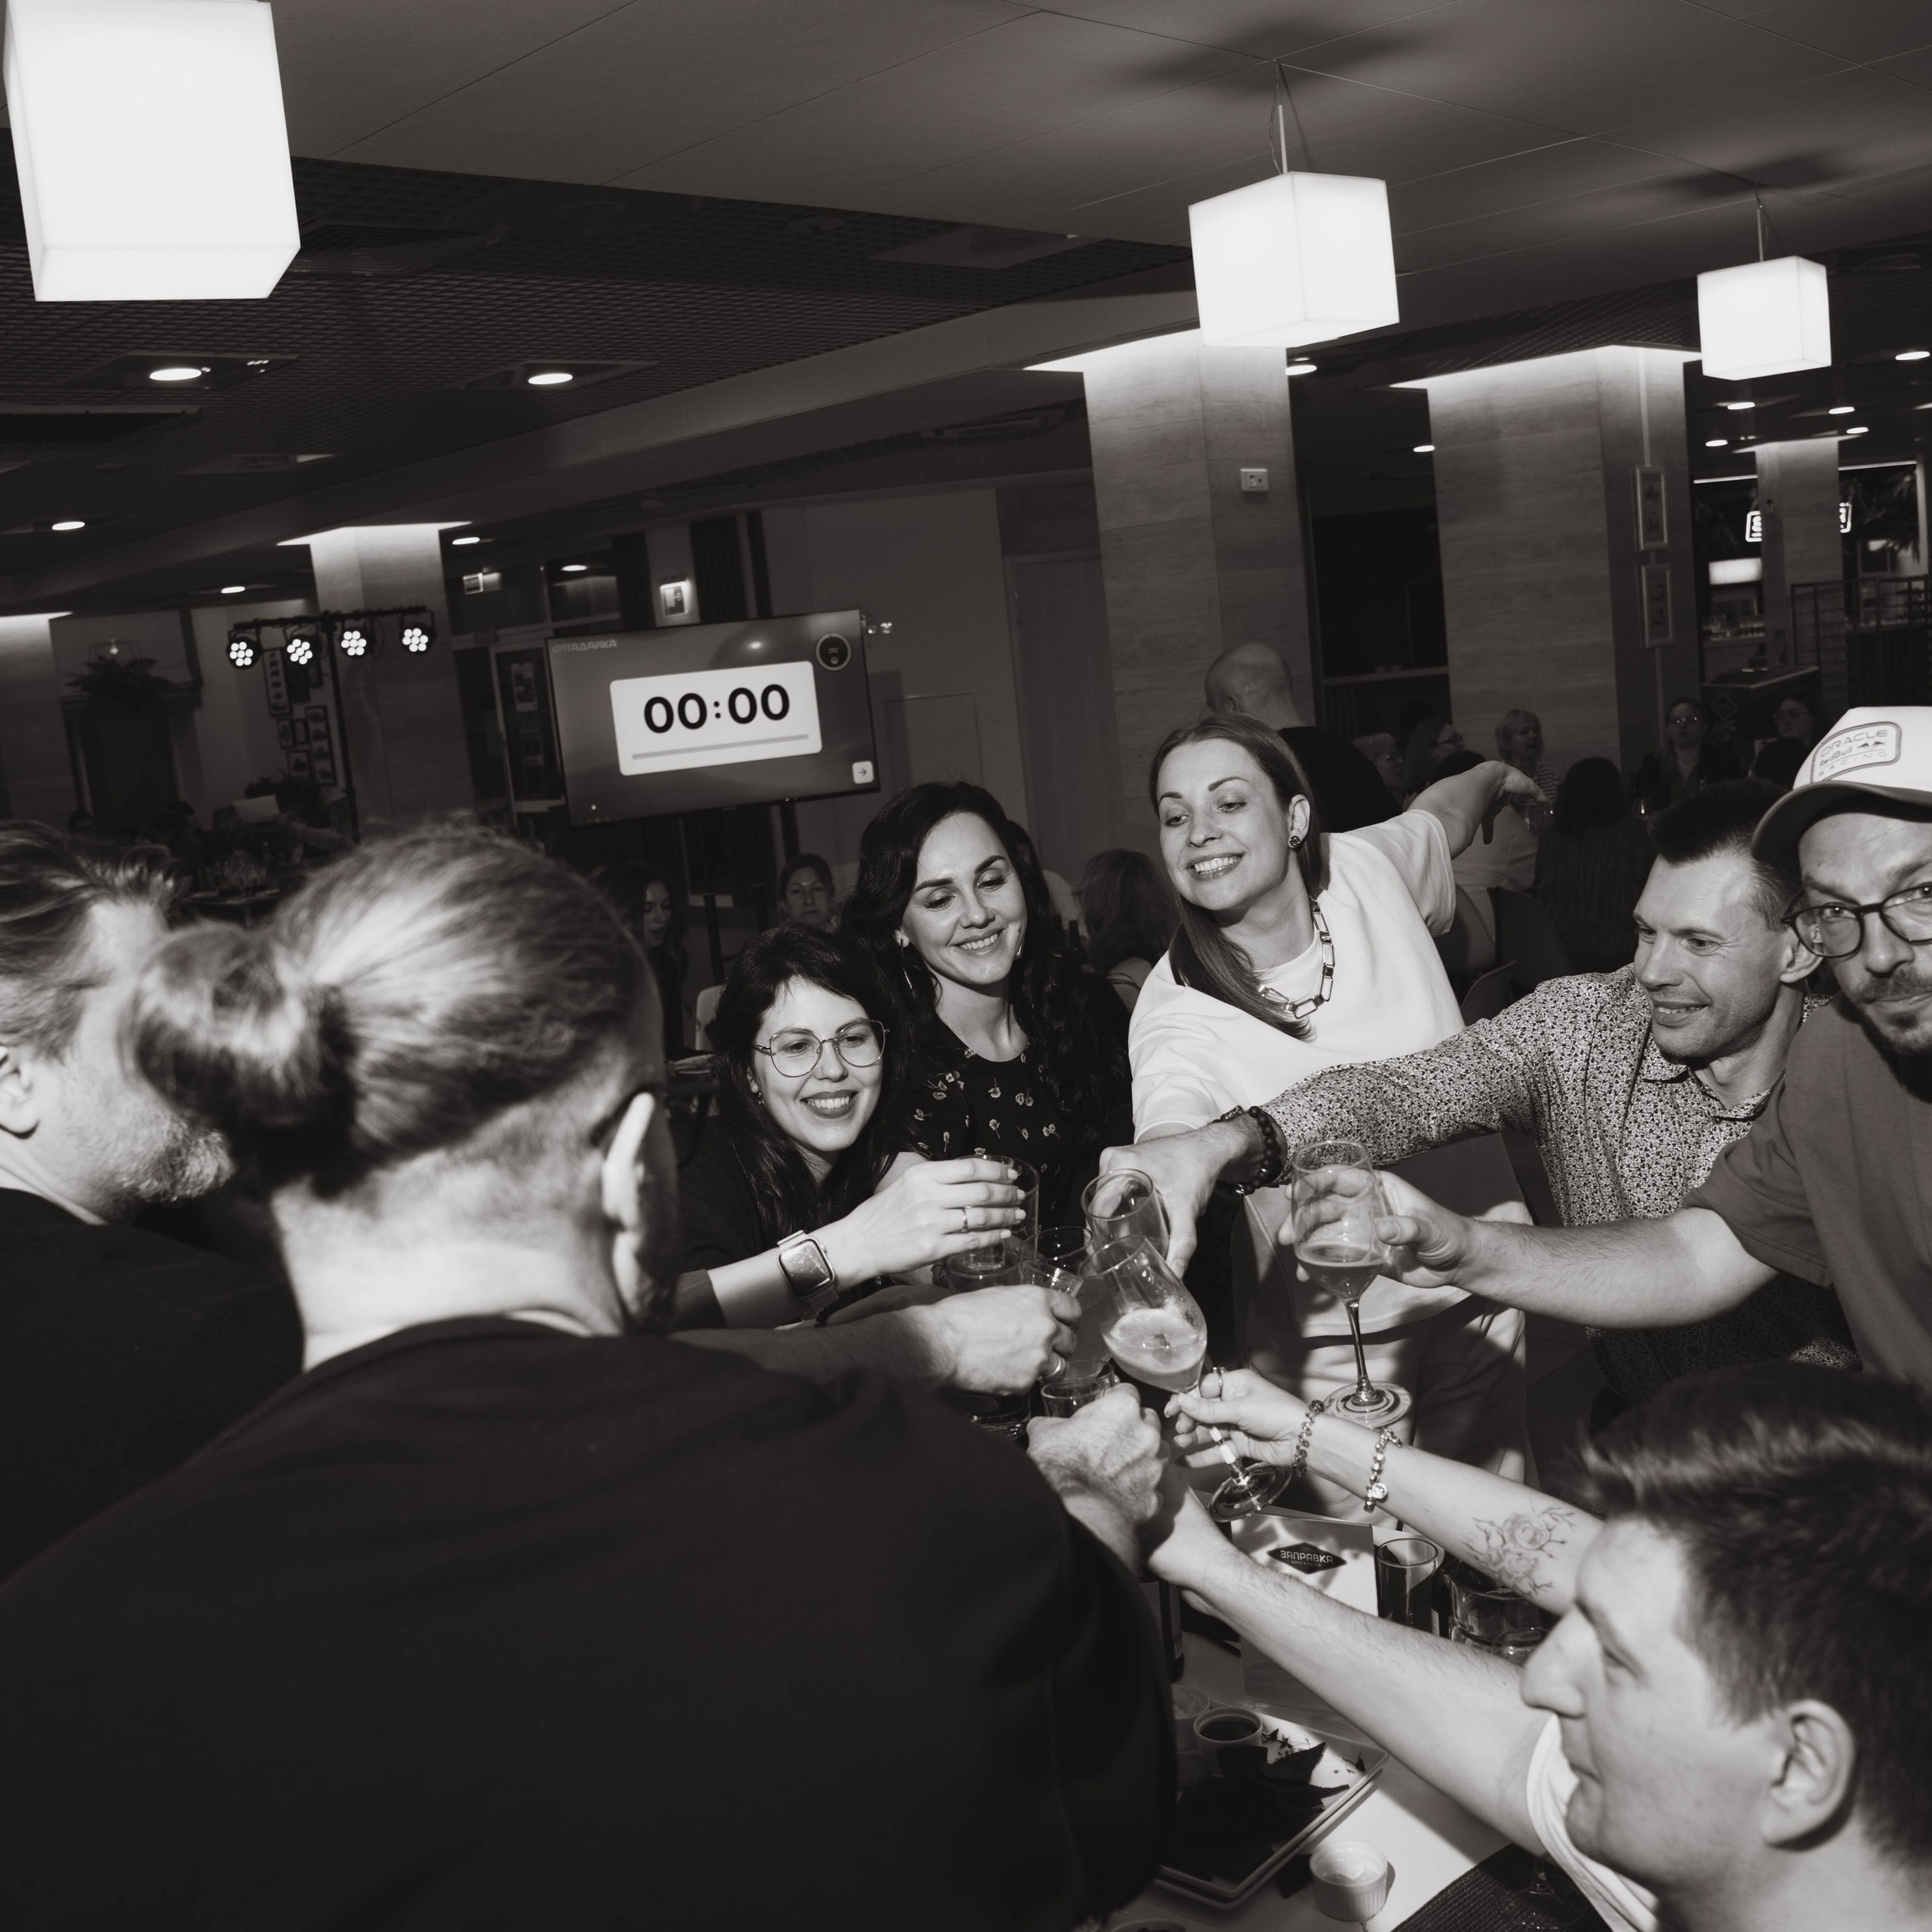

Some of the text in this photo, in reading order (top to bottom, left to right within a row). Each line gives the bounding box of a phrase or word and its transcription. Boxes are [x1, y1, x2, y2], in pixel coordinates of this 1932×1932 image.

[644, 684, 790, 734] 00:00
[1820, 730, 1888, 757] ORACLE
[1280, 1550, 1334, 1564] ЗАПРАВКА
